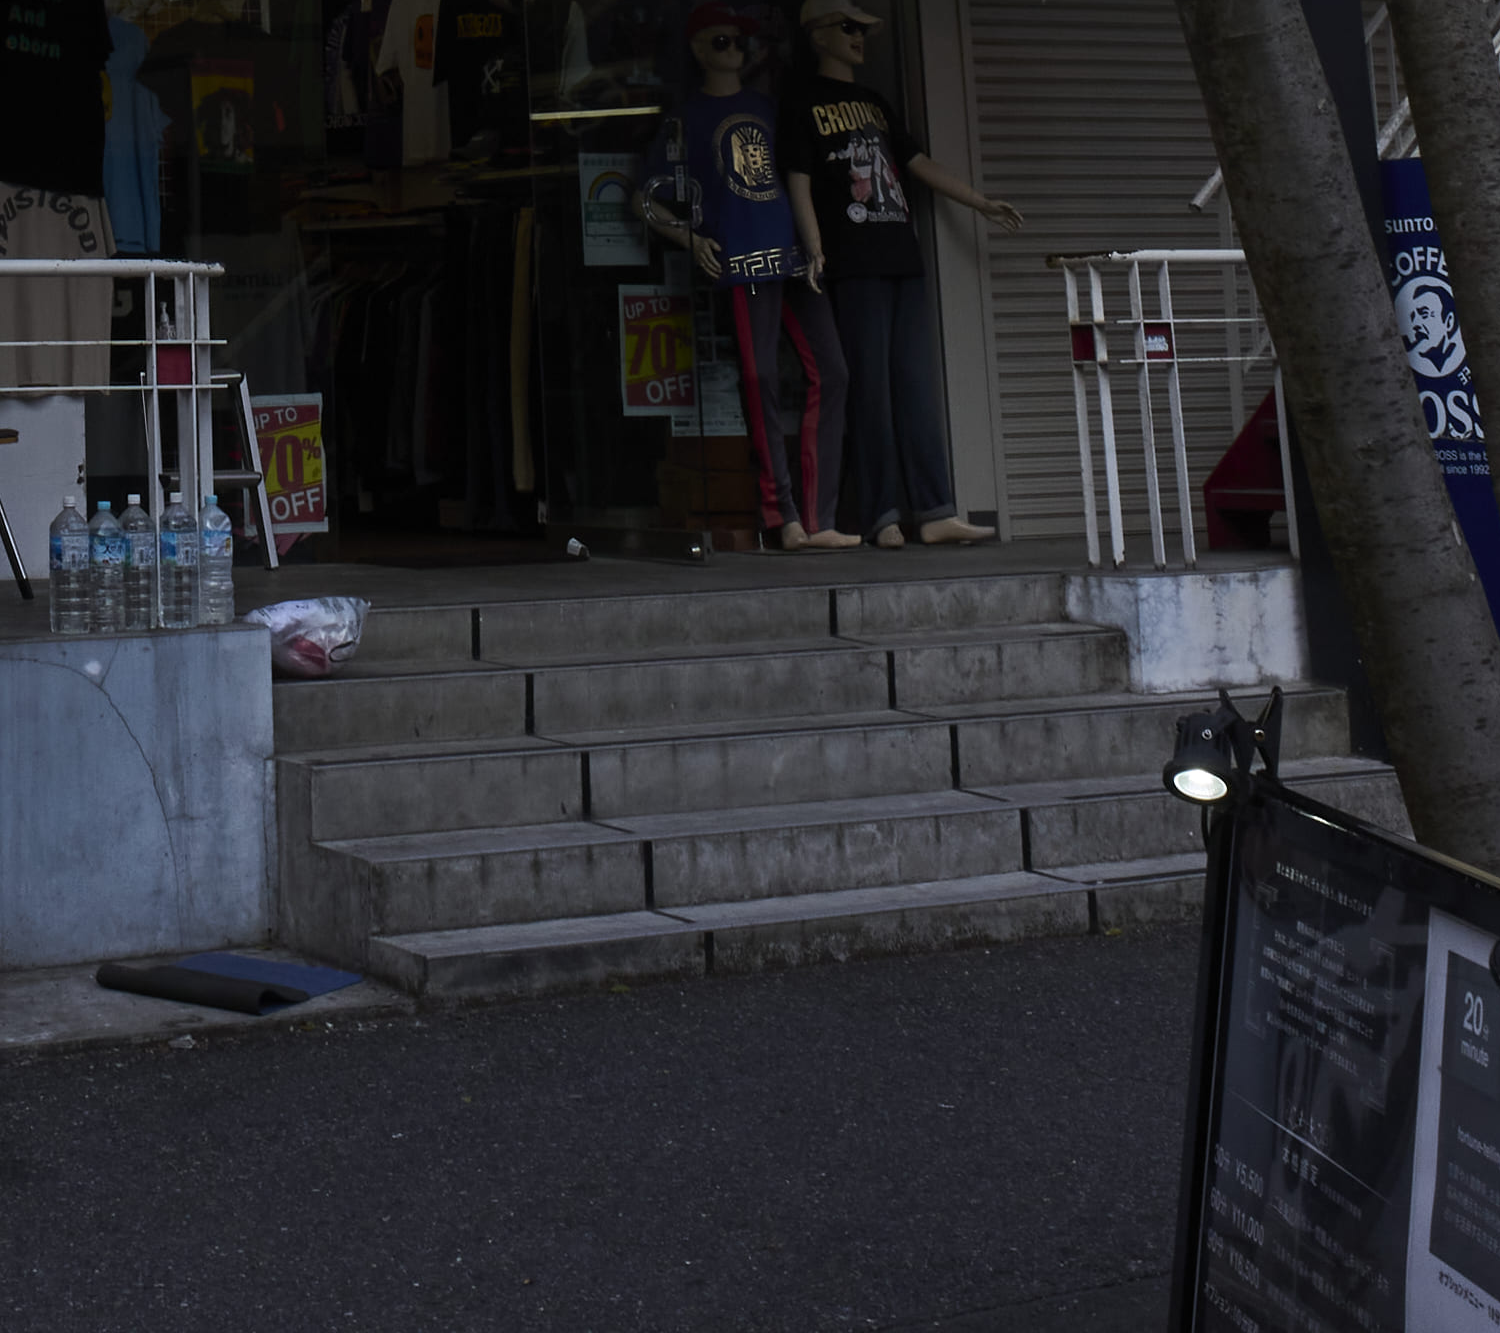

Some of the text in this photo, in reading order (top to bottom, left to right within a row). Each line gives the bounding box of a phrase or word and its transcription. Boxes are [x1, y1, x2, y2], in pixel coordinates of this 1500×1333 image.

[8, 3, 47, 29] And
[625, 297, 671, 320] UP TO
[645, 374, 691, 404] OFF
[274, 407, 297, 425] TO
[271, 487, 321, 521] OFF
[1460, 1038, 1490, 1068] minute
